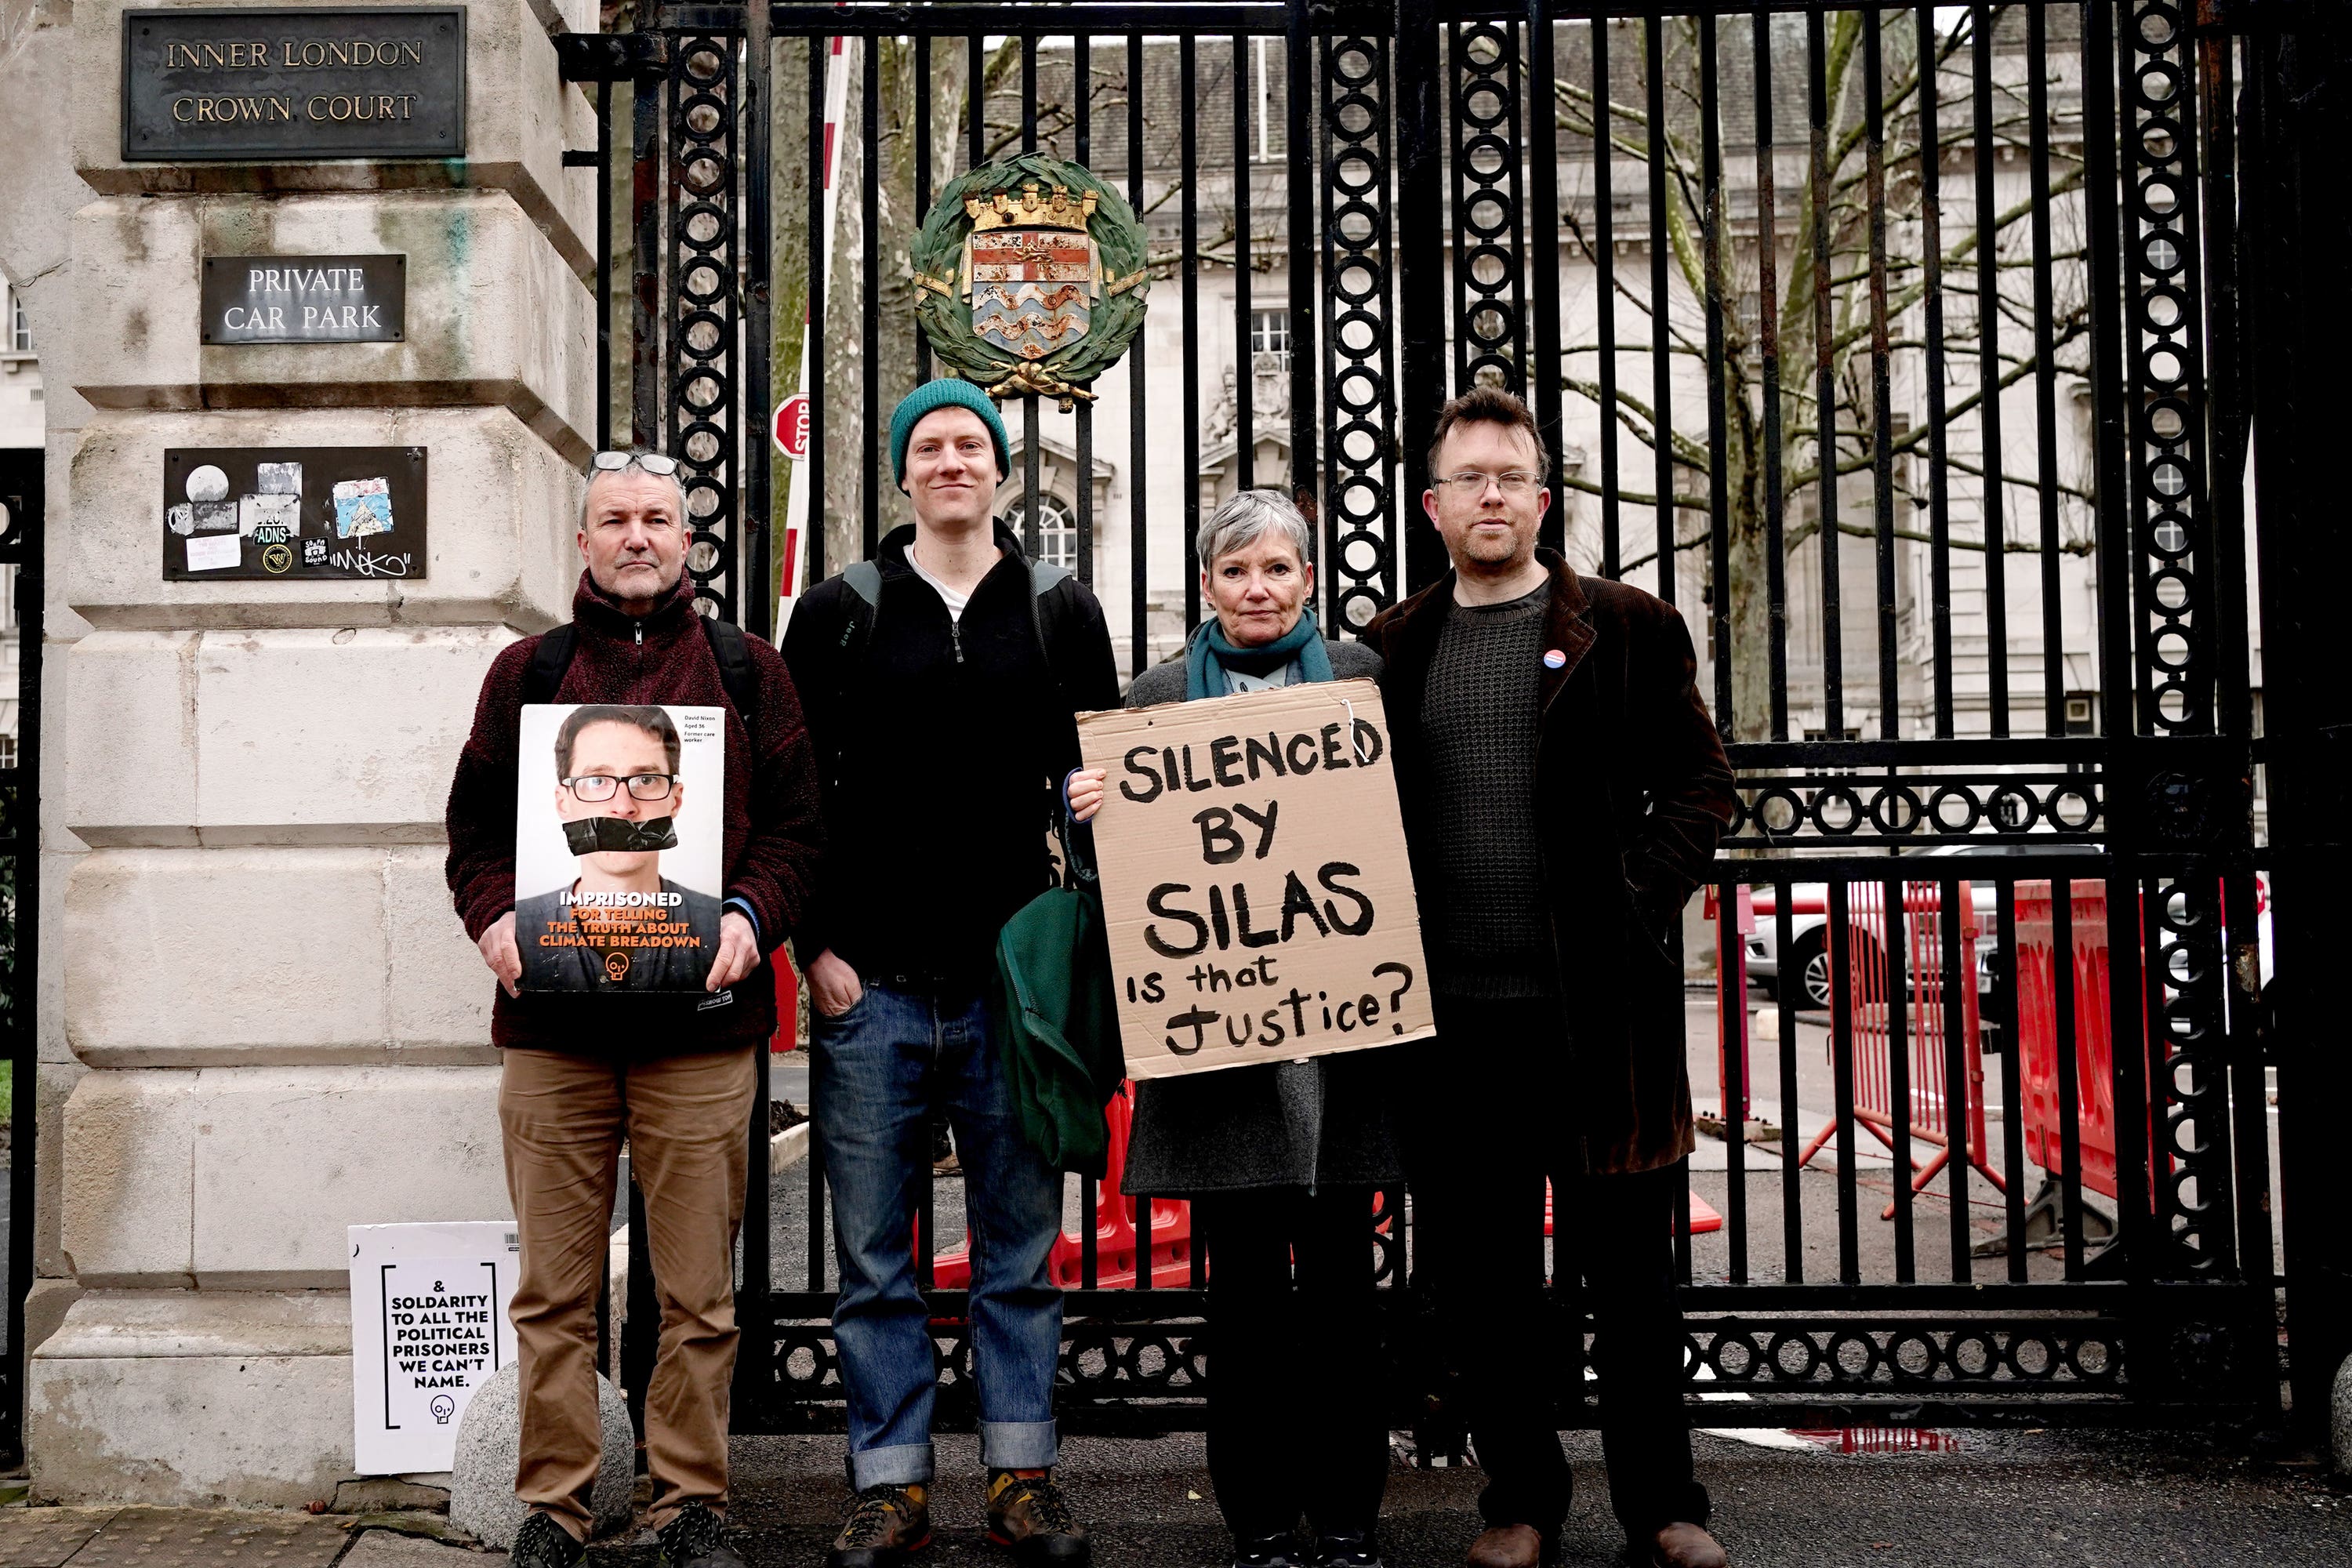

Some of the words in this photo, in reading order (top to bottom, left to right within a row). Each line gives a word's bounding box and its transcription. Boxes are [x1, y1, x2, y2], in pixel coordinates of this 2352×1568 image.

[168, 43, 268, 67] INNER
[283, 42, 422, 66] LONDON
[172, 97, 290, 122] CROWN
[307, 95, 417, 121] COURT
[249, 268, 365, 292] PRIVATE
[223, 307, 286, 330] CAR
[302, 305, 382, 328] PARK
[257, 527, 287, 543] ADNS
[1120, 717, 1384, 804] SILENCED
[1192, 800, 1278, 865] BY
[559, 891, 684, 908] IMPRISONED
[570, 909, 601, 921] FOR
[605, 909, 668, 921] TELLING
[1144, 861, 1375, 959] SILAS
[547, 921, 578, 934] THE
[582, 922, 633, 935] TRUTH
[635, 923, 690, 935] ABOUT
[539, 935, 606, 947] CLIMATE
[610, 936, 701, 948] BREADOWN
[1186, 955, 1279, 993] that
[1165, 961, 1414, 1056] Justice?
[433, 1280, 445, 1293] &
[391, 1295, 488, 1310] SOLDARITY
[391, 1312, 415, 1326] TO
[419, 1312, 451, 1325] ALL
[455, 1311, 488, 1323] THE
[397, 1327, 485, 1341] POLITICAL
[393, 1342, 490, 1358] PRISONERS
[398, 1360, 426, 1373] WE
[432, 1358, 485, 1372] CAN'T
[414, 1375, 470, 1388] NAME.
